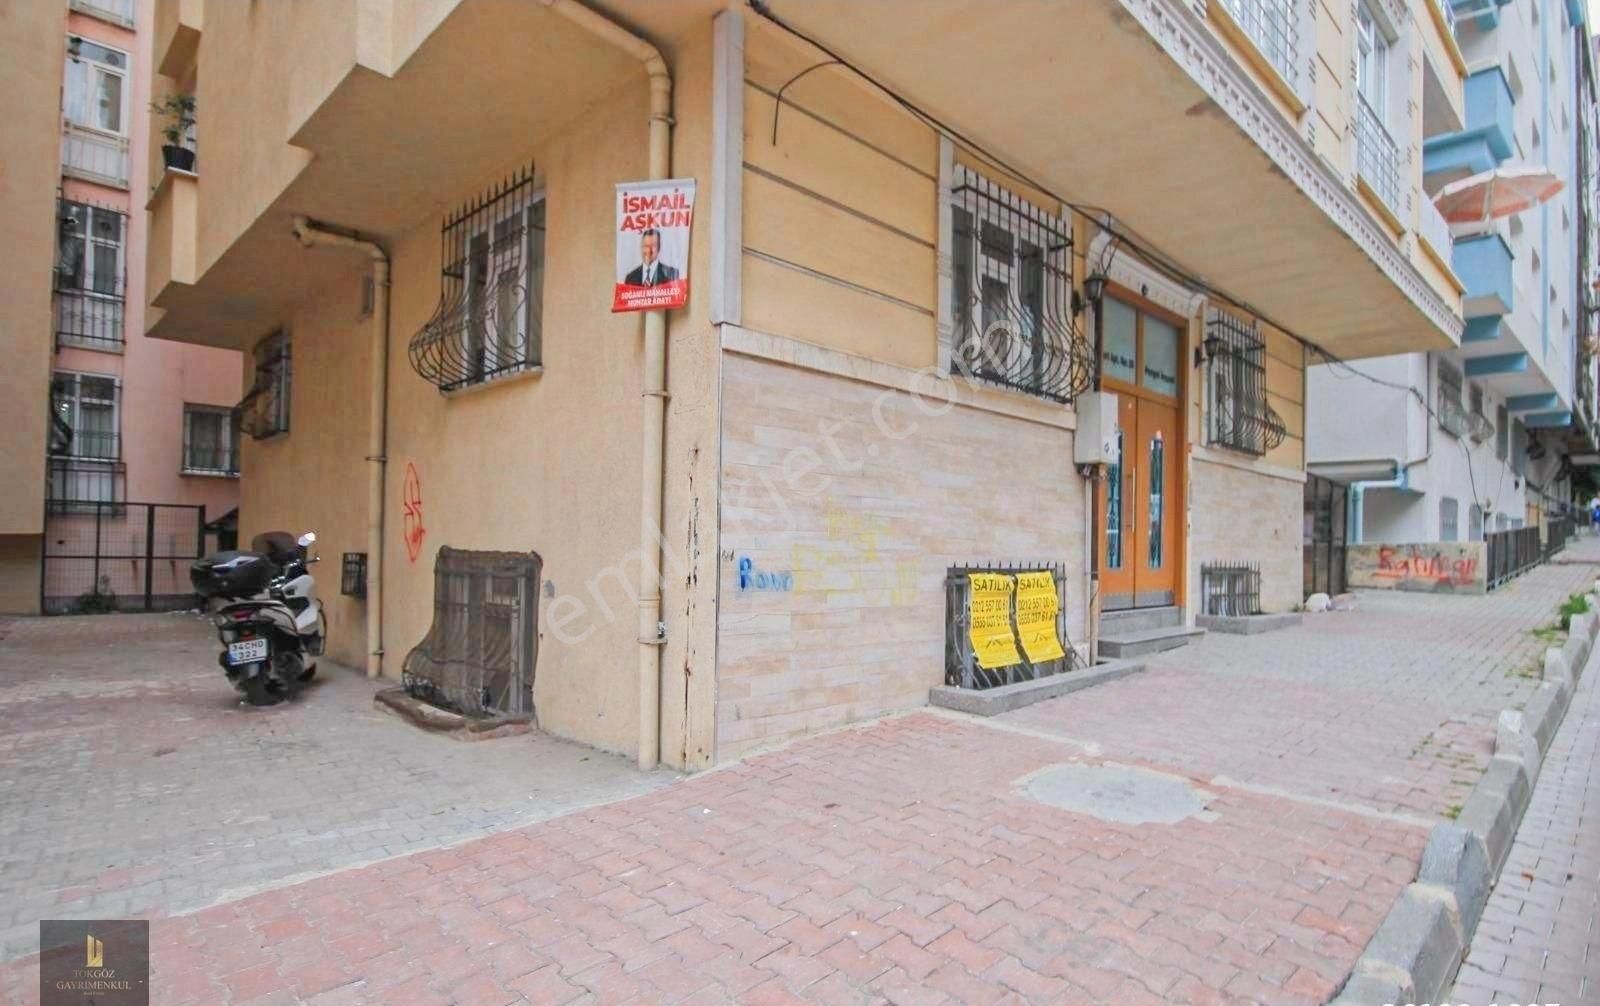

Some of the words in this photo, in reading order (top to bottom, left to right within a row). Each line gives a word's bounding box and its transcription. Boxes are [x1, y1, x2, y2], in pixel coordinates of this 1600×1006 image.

[623, 188, 690, 213] İSMAİL
[621, 211, 689, 234] AŞKUN
[974, 579, 1011, 592] SATILIK
[238, 650, 257, 659] 322
